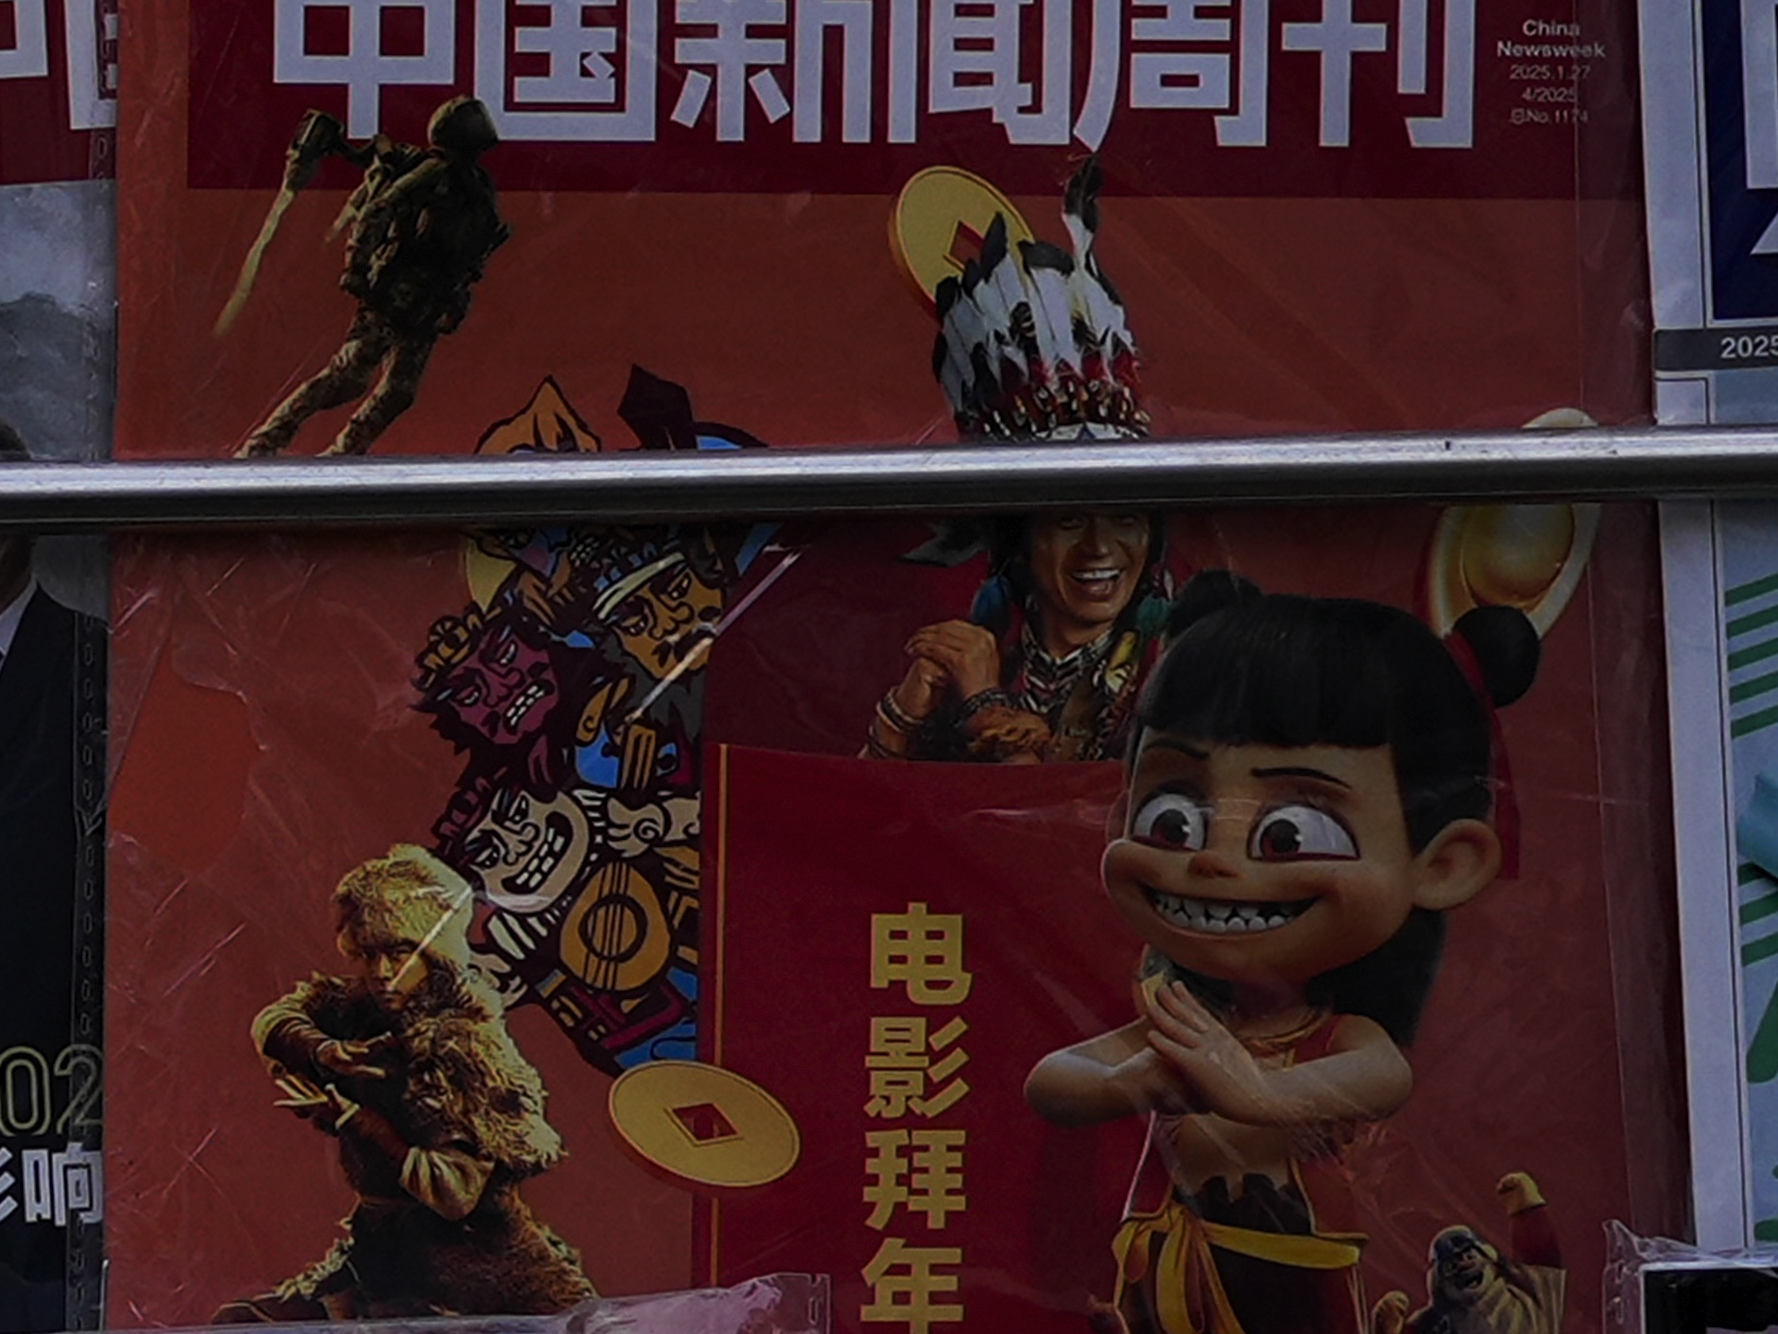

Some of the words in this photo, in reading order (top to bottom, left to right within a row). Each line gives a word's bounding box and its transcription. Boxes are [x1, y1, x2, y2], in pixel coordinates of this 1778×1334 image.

[1522, 18, 1581, 38] China
[1496, 40, 1606, 59] Newsweek
[1521, 86, 1579, 104] 4/2025
